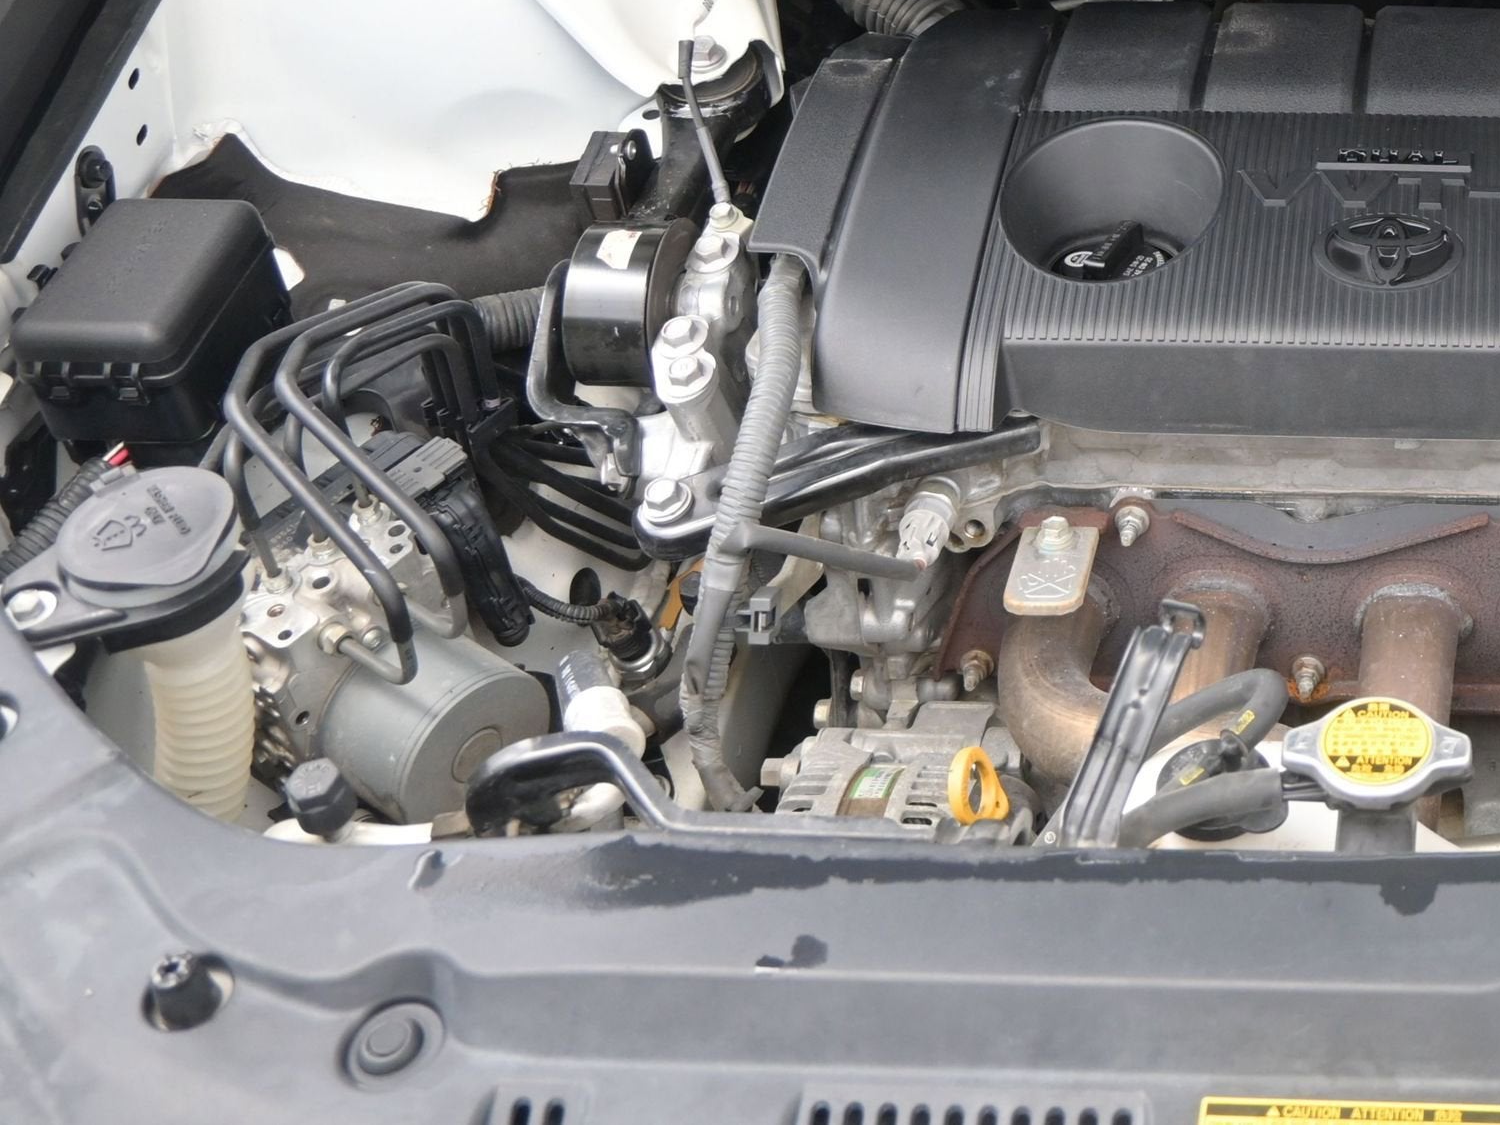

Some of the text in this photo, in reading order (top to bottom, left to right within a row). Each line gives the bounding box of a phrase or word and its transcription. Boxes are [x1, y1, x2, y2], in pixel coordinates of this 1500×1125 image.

[1356, 709, 1410, 719] CAUTION
[1355, 755, 1413, 765] ATTENTION
[1282, 1105, 1341, 1118] CAUTION
[1350, 1107, 1425, 1121] ATTENTION
